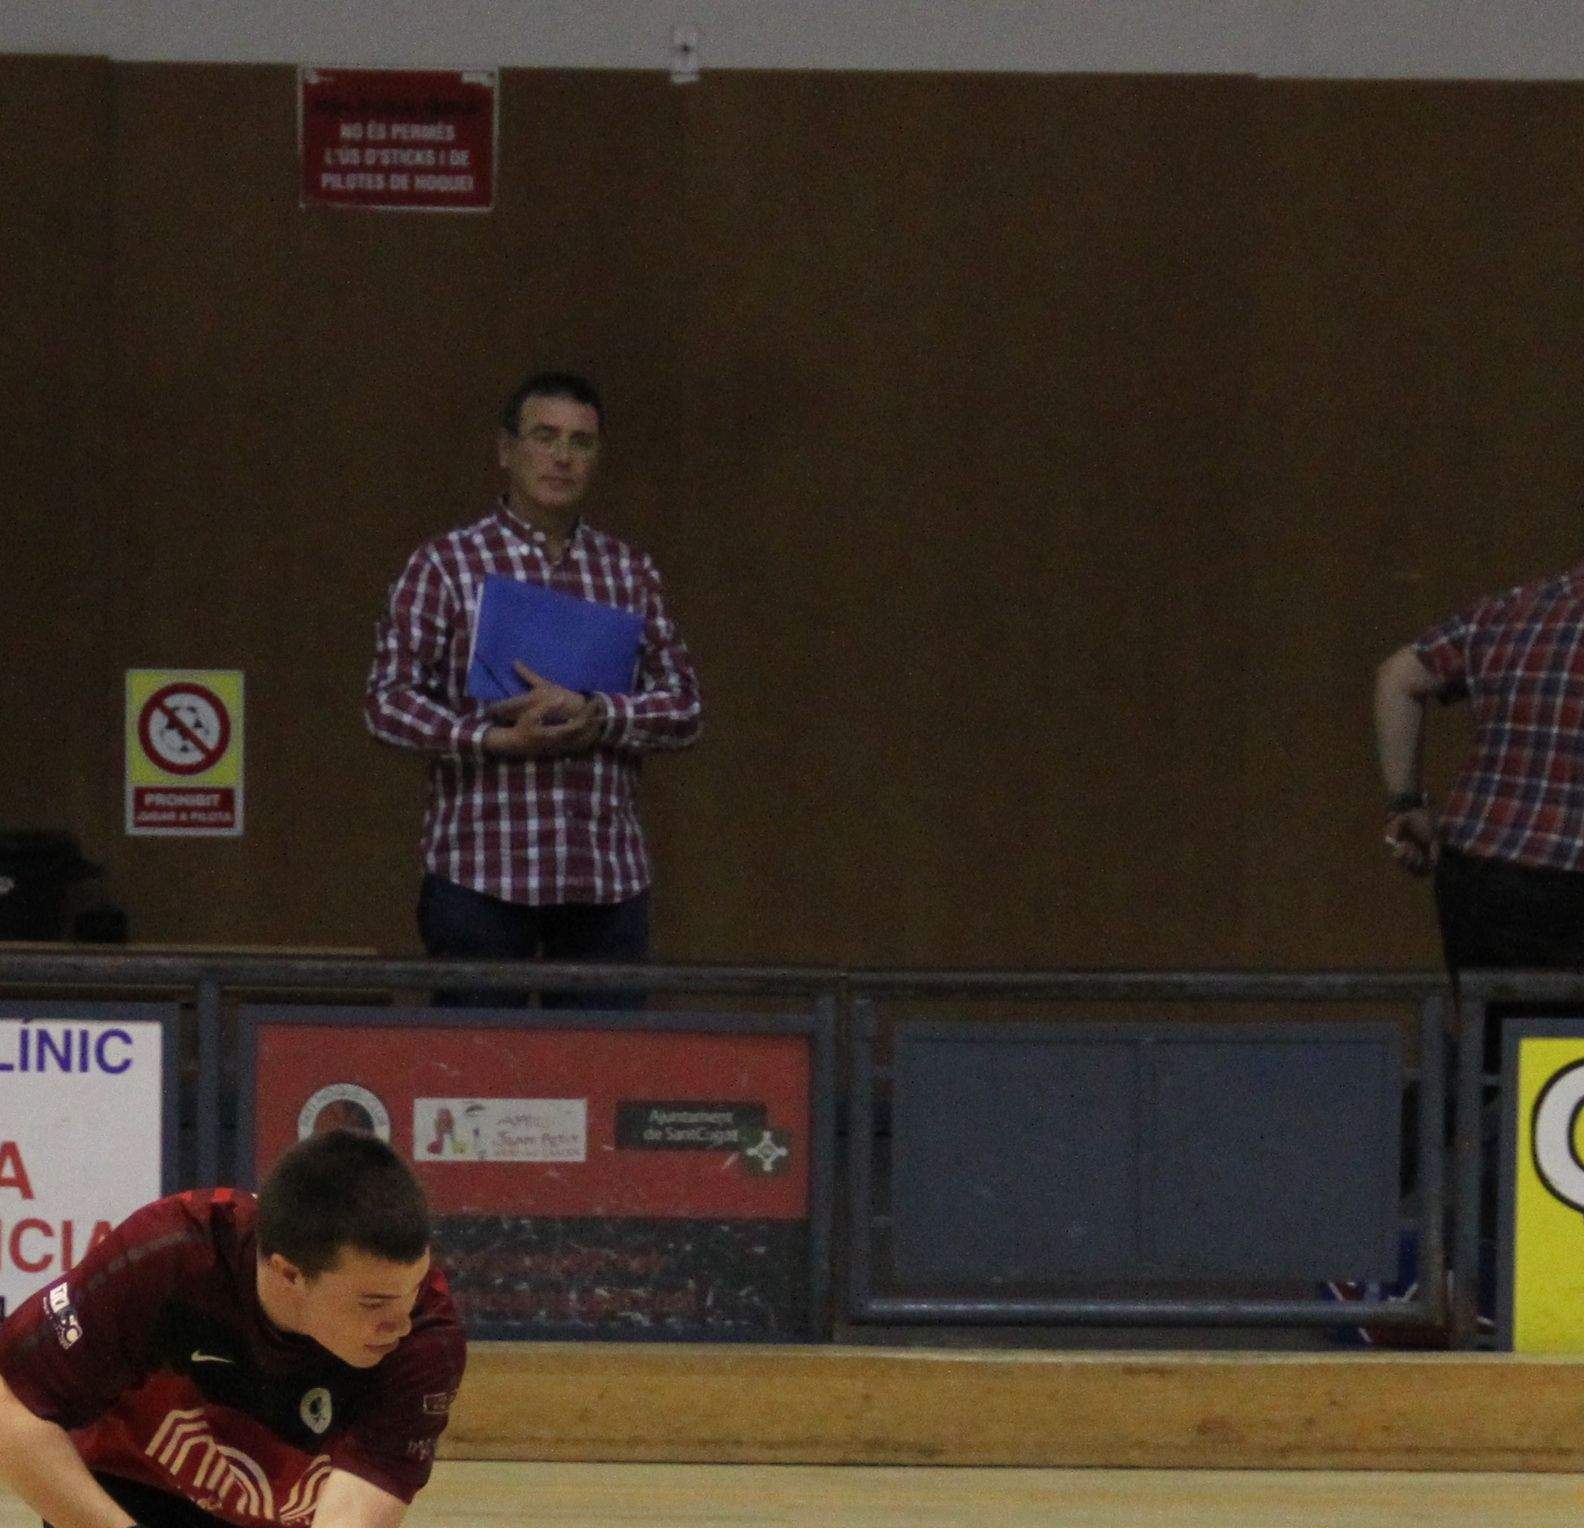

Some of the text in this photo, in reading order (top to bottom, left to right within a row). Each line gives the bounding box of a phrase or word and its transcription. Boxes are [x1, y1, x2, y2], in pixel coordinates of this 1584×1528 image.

[339, 122, 363, 140] NO
[449, 149, 471, 167] DE
[320, 172, 385, 190] PILOTES
[389, 173, 409, 191] DE
